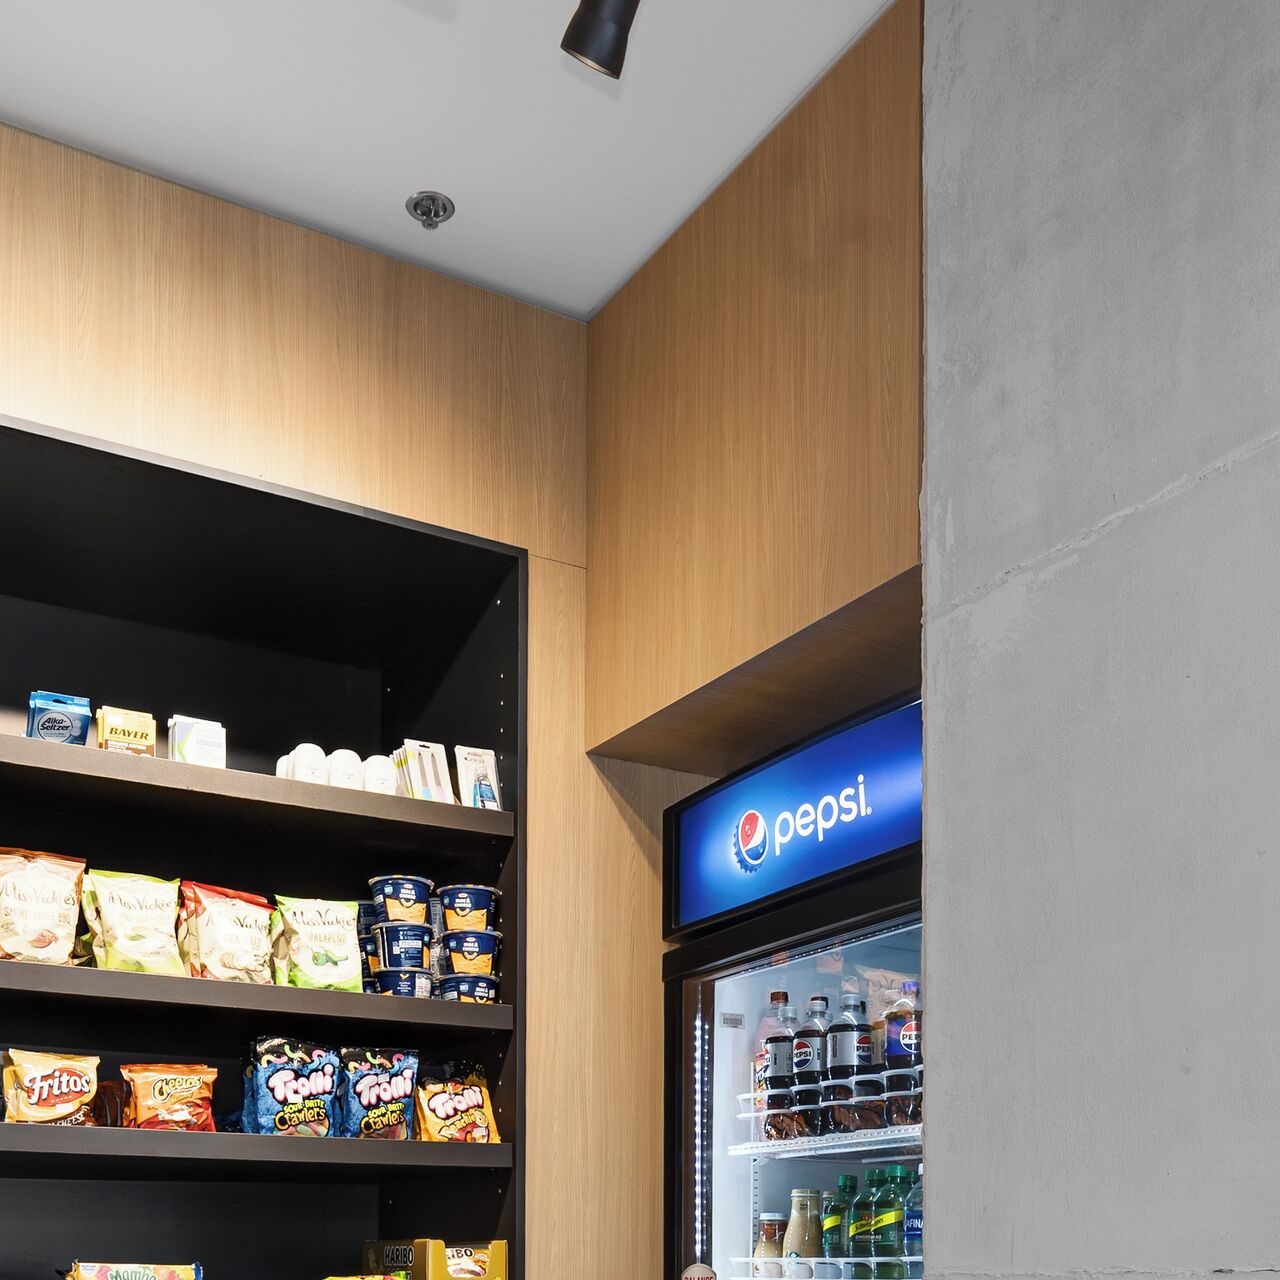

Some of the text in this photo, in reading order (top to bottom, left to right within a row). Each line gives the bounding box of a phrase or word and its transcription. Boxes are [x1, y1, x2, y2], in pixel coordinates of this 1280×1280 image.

[40, 722, 71, 732] Seltzer
[44, 716, 67, 726] Alka-
[109, 727, 149, 741] BAYER
[774, 774, 866, 856] pepsi
[23, 1068, 90, 1105] Fritos
[152, 1076, 203, 1102] Cheetos
[268, 1064, 334, 1103] Trolli
[355, 1070, 414, 1107] Trolli
[283, 1101, 304, 1113] SOUR
[368, 1107, 386, 1119] SOUR
[429, 1086, 483, 1118] Trolli
[275, 1108, 326, 1130] Crawlers
[360, 1112, 405, 1134] Crawlers
[384, 1245, 415, 1267] HARIBO
